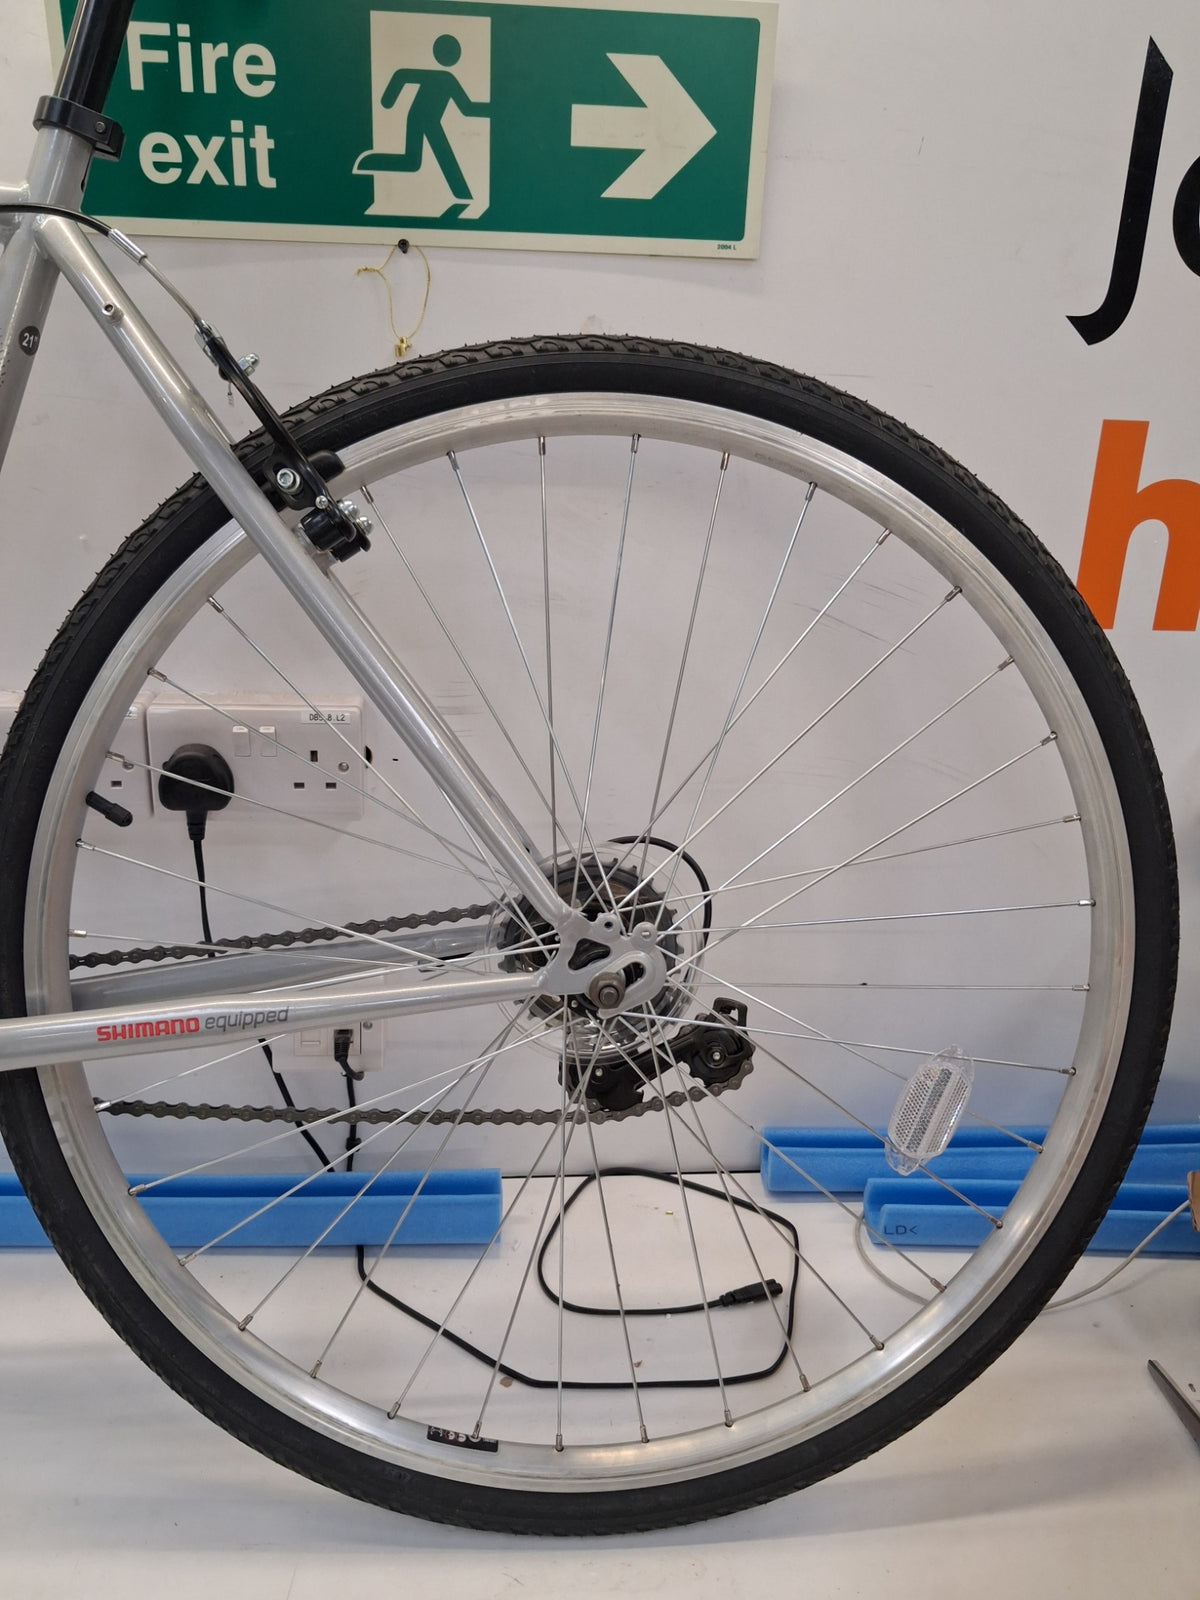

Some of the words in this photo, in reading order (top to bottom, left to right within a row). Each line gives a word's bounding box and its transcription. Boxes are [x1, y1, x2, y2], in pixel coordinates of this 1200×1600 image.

[125, 20, 277, 98] Fire
[138, 119, 278, 189] exit
[1066, 35, 1200, 346] J
[97, 1017, 200, 1042] SHIMANO
[205, 1006, 289, 1032] equipped
